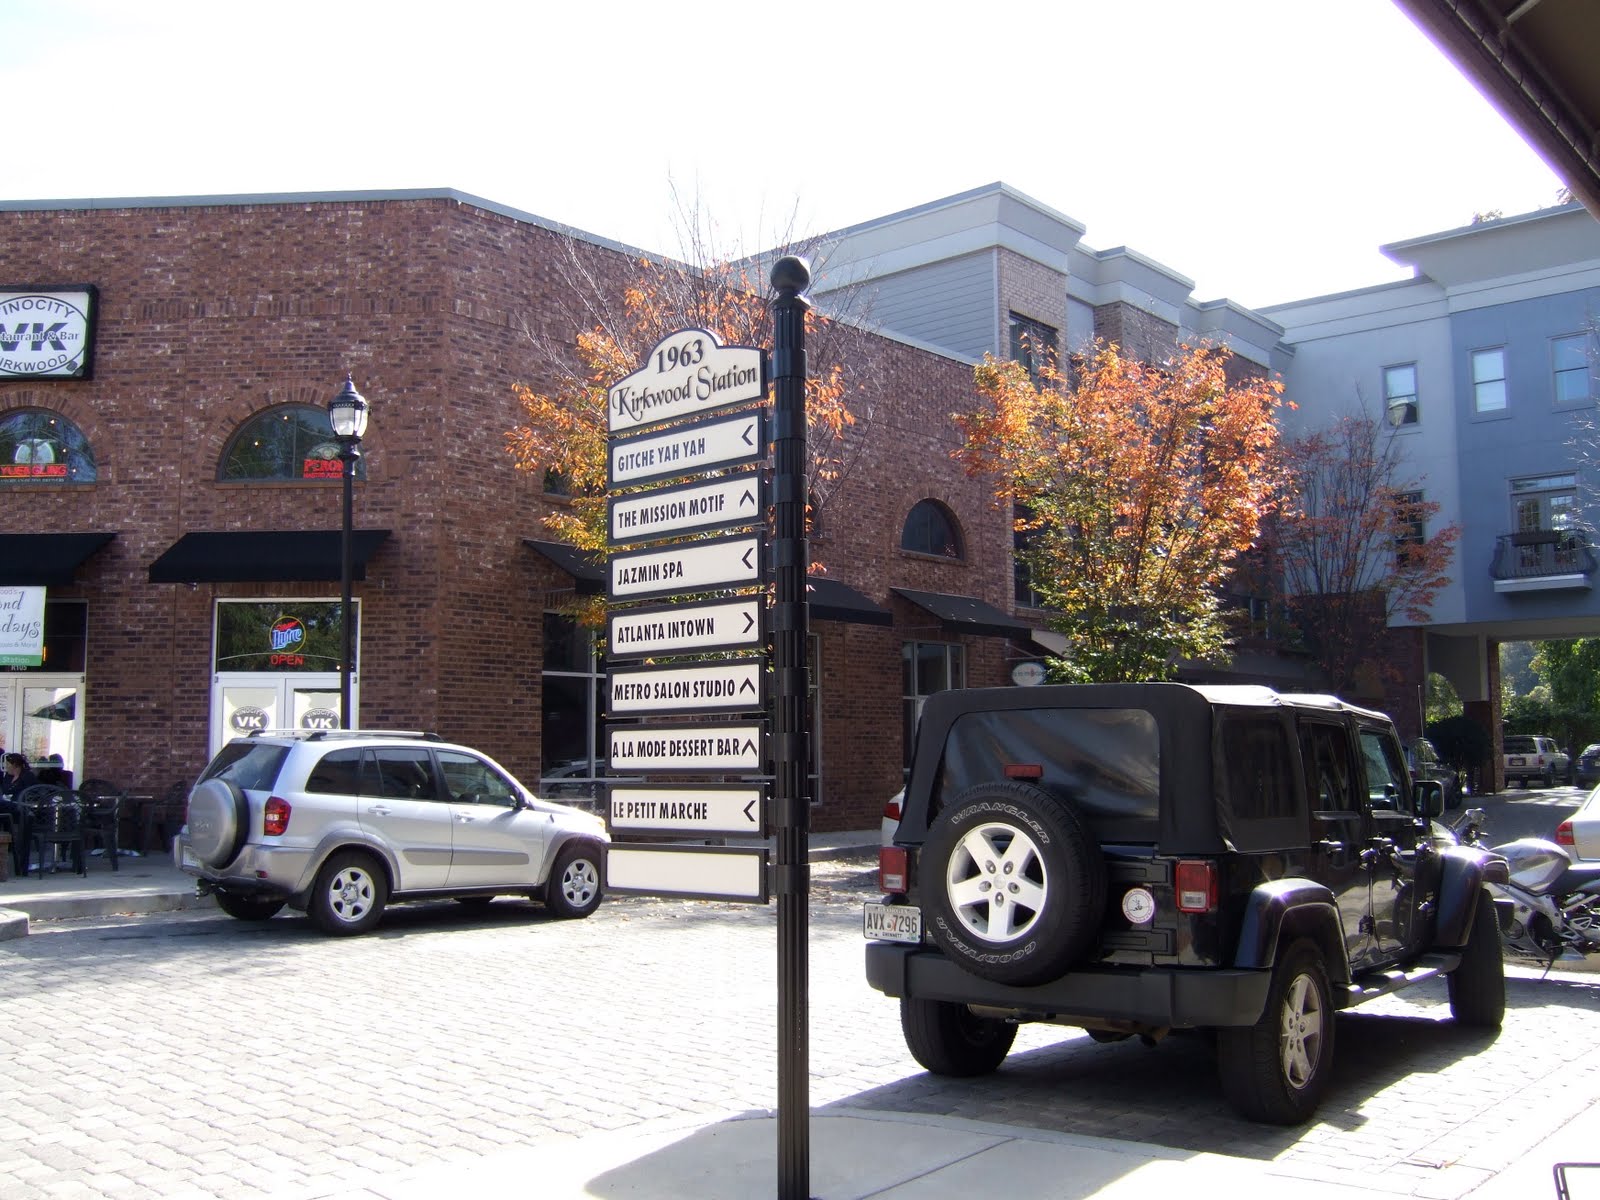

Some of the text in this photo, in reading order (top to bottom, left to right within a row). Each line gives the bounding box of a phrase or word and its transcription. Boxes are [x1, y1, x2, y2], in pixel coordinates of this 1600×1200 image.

[60, 331, 79, 340] Bar
[656, 339, 704, 374] 1963
[612, 364, 757, 421] Kirkwood Station
[618, 437, 706, 472] GITCHE YAH YAH
[618, 494, 725, 528] THE MISSION MOTIF
[618, 561, 683, 586] JAZMIN SPA
[617, 617, 715, 644] ATLANTA INTOWN
[270, 654, 304, 666] OPEN
[614, 679, 735, 701] METRO SALON STUDIO
[236, 716, 262, 727] VK
[307, 718, 333, 729] VK
[612, 738, 740, 758] A LA MODE DESSERT BAR
[613, 801, 708, 820] LE PETIT MARCHE
[951, 802, 1051, 845] WRANGLER
[867, 912, 918, 934] AVX 7296
[936, 916, 1037, 964] GOODYEAR
